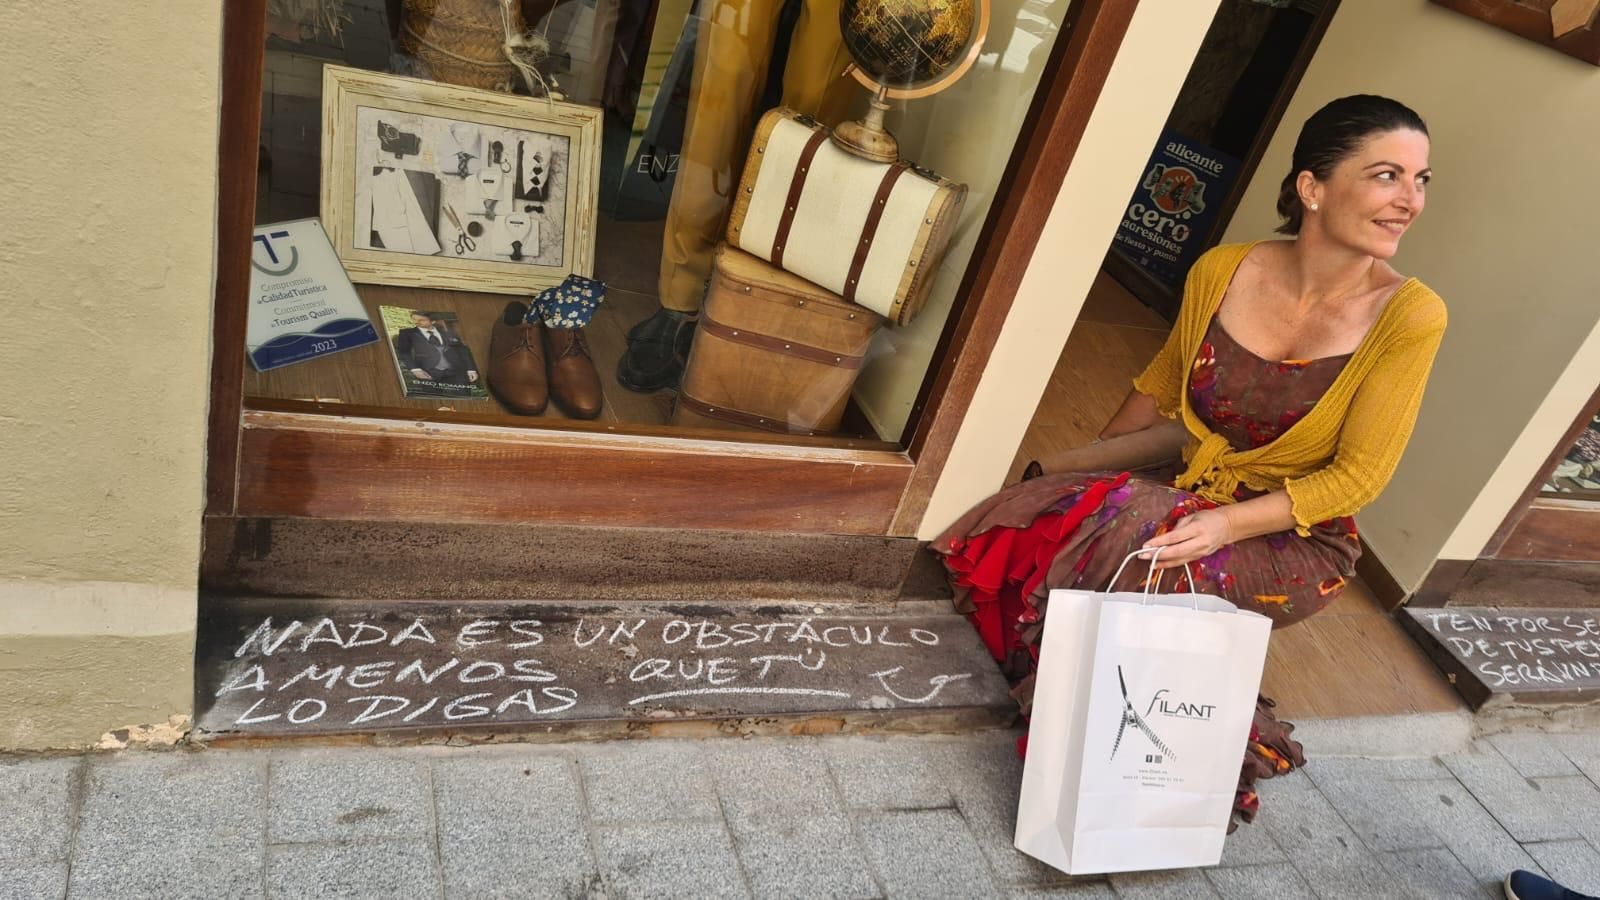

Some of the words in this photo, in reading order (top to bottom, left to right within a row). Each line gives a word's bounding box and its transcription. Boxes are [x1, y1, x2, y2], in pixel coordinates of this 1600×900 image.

[637, 154, 681, 173] ENZ
[1166, 141, 1224, 173] alicante
[1128, 203, 1191, 242] cero
[1154, 248, 1177, 262] punto
[261, 278, 313, 292] Compromiso
[261, 290, 293, 303] Calidad
[273, 314, 308, 327] Tourism
[309, 306, 338, 319] Quality
[312, 339, 337, 353] 2023
[1425, 613, 1493, 632] TEN
[1496, 616, 1562, 633] POR
[234, 616, 436, 657] NADA
[455, 619, 544, 650] ES
[574, 617, 647, 648] UN
[662, 617, 940, 649] OBSTÁCULO
[1447, 637, 1500, 658] DE
[1501, 639, 1555, 660] TUS
[215, 663, 270, 697] A
[278, 657, 558, 691] MENOS
[629, 656, 738, 685] QUE
[234, 697, 328, 725] LO
[347, 686, 579, 725] DIGAS
